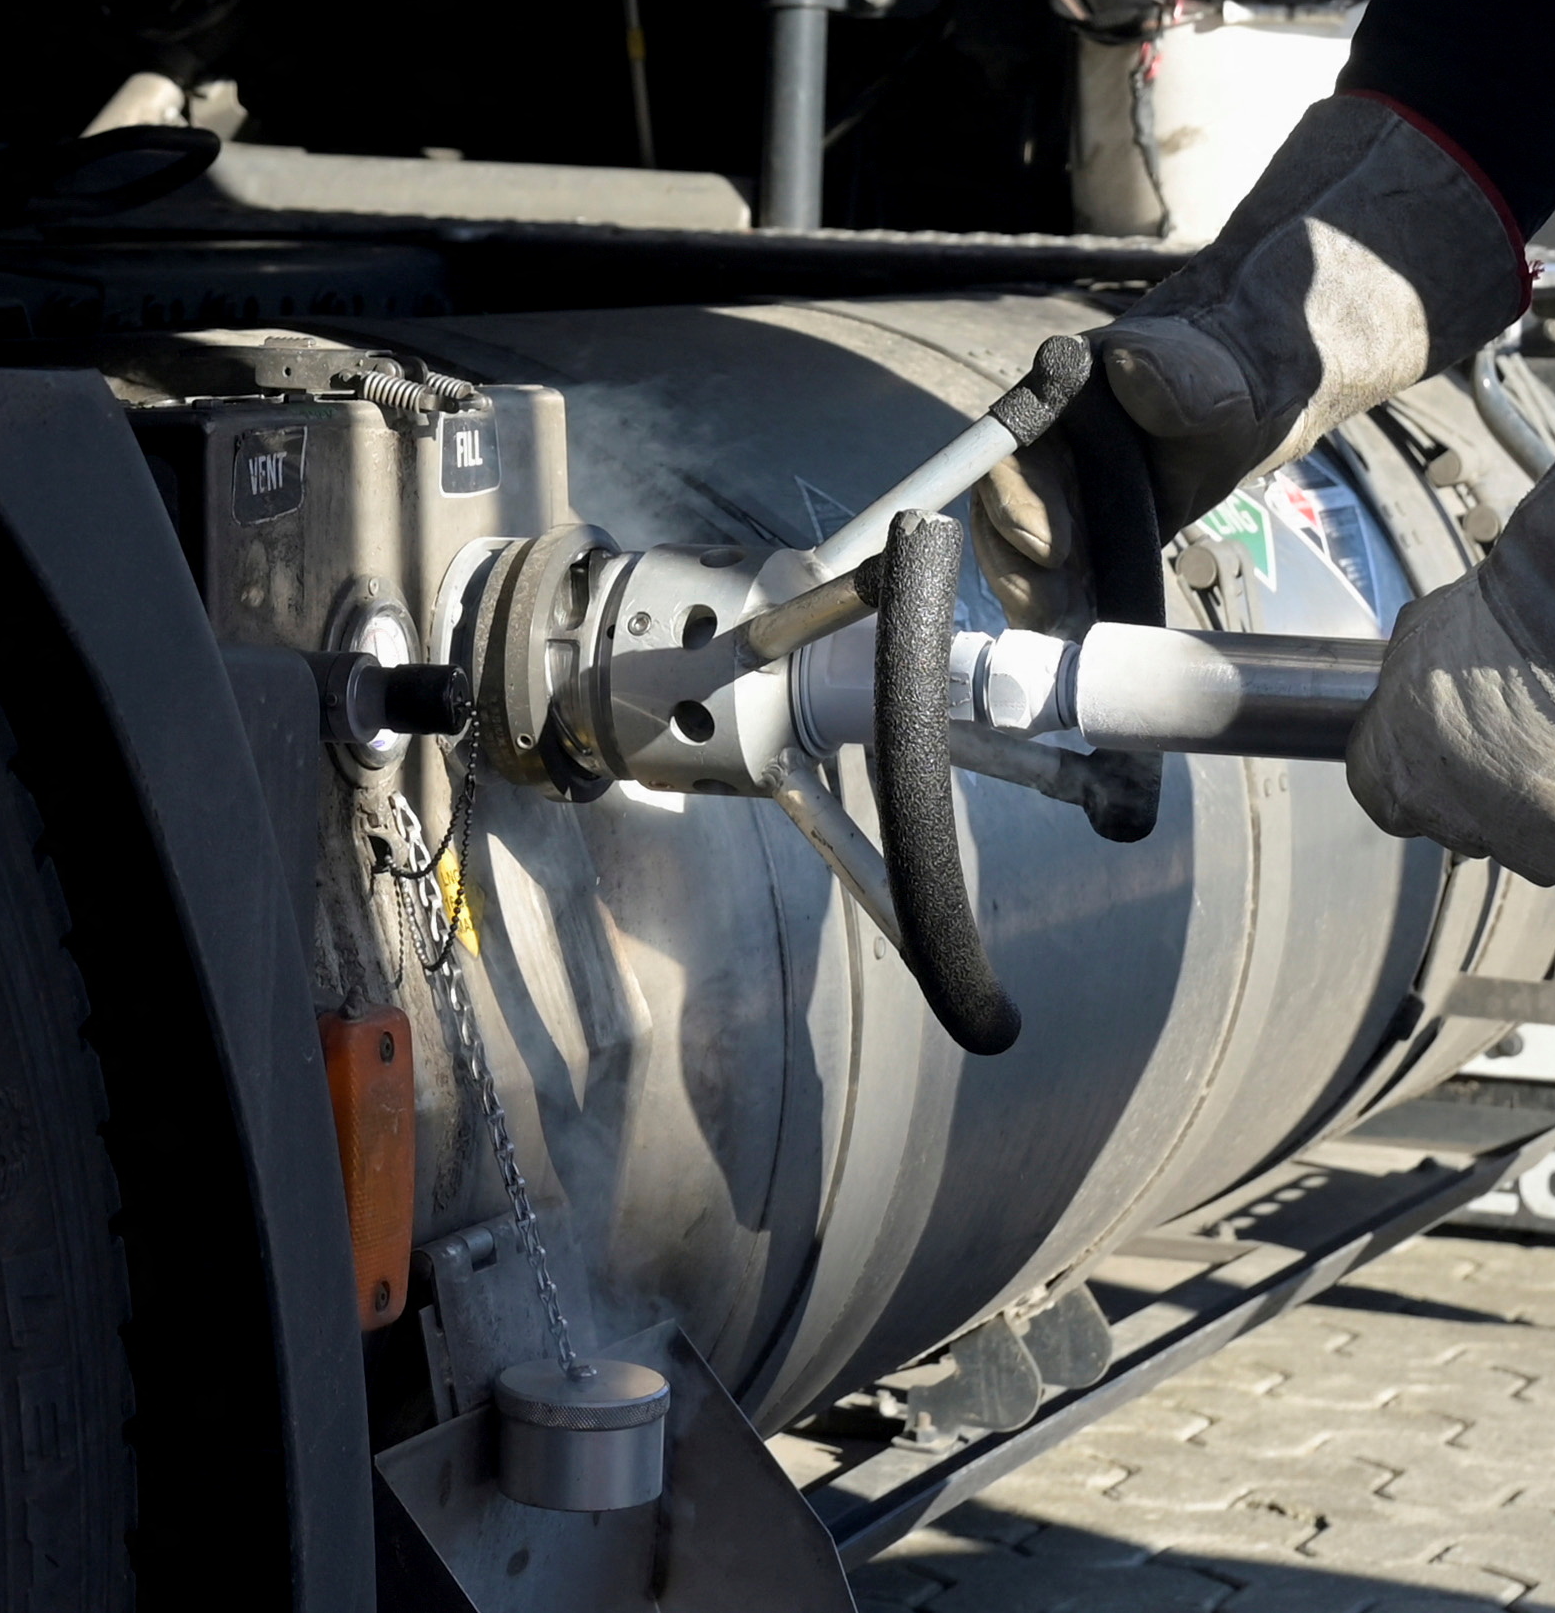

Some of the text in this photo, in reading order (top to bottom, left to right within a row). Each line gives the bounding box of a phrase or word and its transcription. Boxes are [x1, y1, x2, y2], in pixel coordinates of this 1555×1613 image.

[455, 429, 483, 469] FILL
[248, 450, 287, 496] VENT
[1206, 494, 1259, 536] LNG
